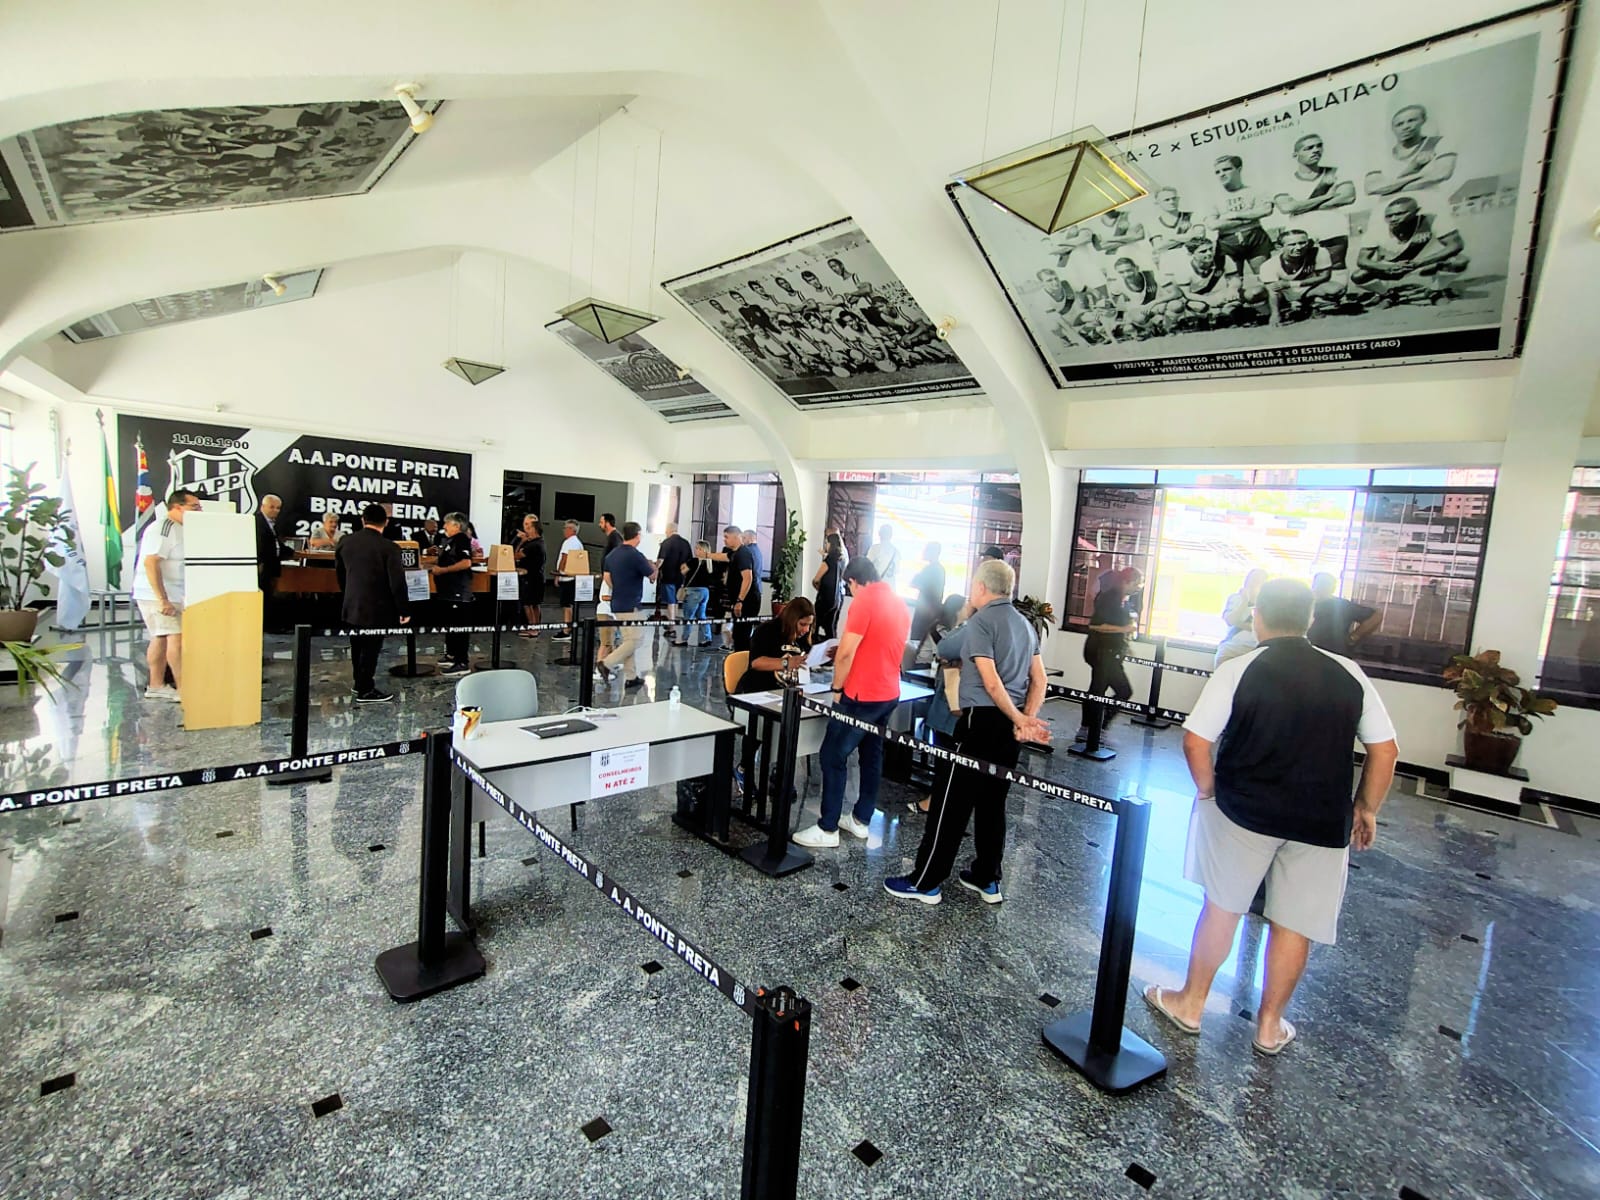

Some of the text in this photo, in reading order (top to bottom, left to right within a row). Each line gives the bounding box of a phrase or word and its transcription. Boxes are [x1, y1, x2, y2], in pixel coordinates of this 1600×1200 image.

[1190, 118, 1253, 147] ESTUD.
[1256, 117, 1270, 129] DE
[1275, 111, 1292, 123] LA
[1162, 356, 1208, 366] MAJESTOSO
[1216, 353, 1245, 363] PONTE
[1247, 351, 1273, 360] PRETA
[1300, 342, 1368, 355] ESTUDIANTES
[1370, 339, 1401, 350] (ARG)
[1193, 363, 1227, 371] CONTRA
[1229, 361, 1249, 369] UMA
[1251, 358, 1284, 367] EQUIPE
[1287, 353, 1352, 364] ESTRANGEIRA
[172, 433, 249, 450] 11.08.1900
[402, 460, 459, 480] PRETA
[332, 474, 423, 498] CAMPEÃ
[310, 496, 440, 521] BRASEIRA
[1088, 694, 1115, 705] PONTE
[1116, 700, 1141, 711] PRETA
[815, 704, 879, 735] A. A. PONTE PRETA
[234, 748, 386, 779] A. A. PONTE PRETA
[898, 735, 980, 771] A. A. PONTE PRETA
[30, 784, 110, 806] PONTE
[116, 775, 183, 794] PRETA
[605, 782, 611, 790] N
[1005, 771, 1113, 812] A. A. PONTE PRETA
[535, 824, 561, 854] PONTE
[561, 844, 589, 877] PRETA
[611, 886, 720, 987] A. A. PONTE PRETA
